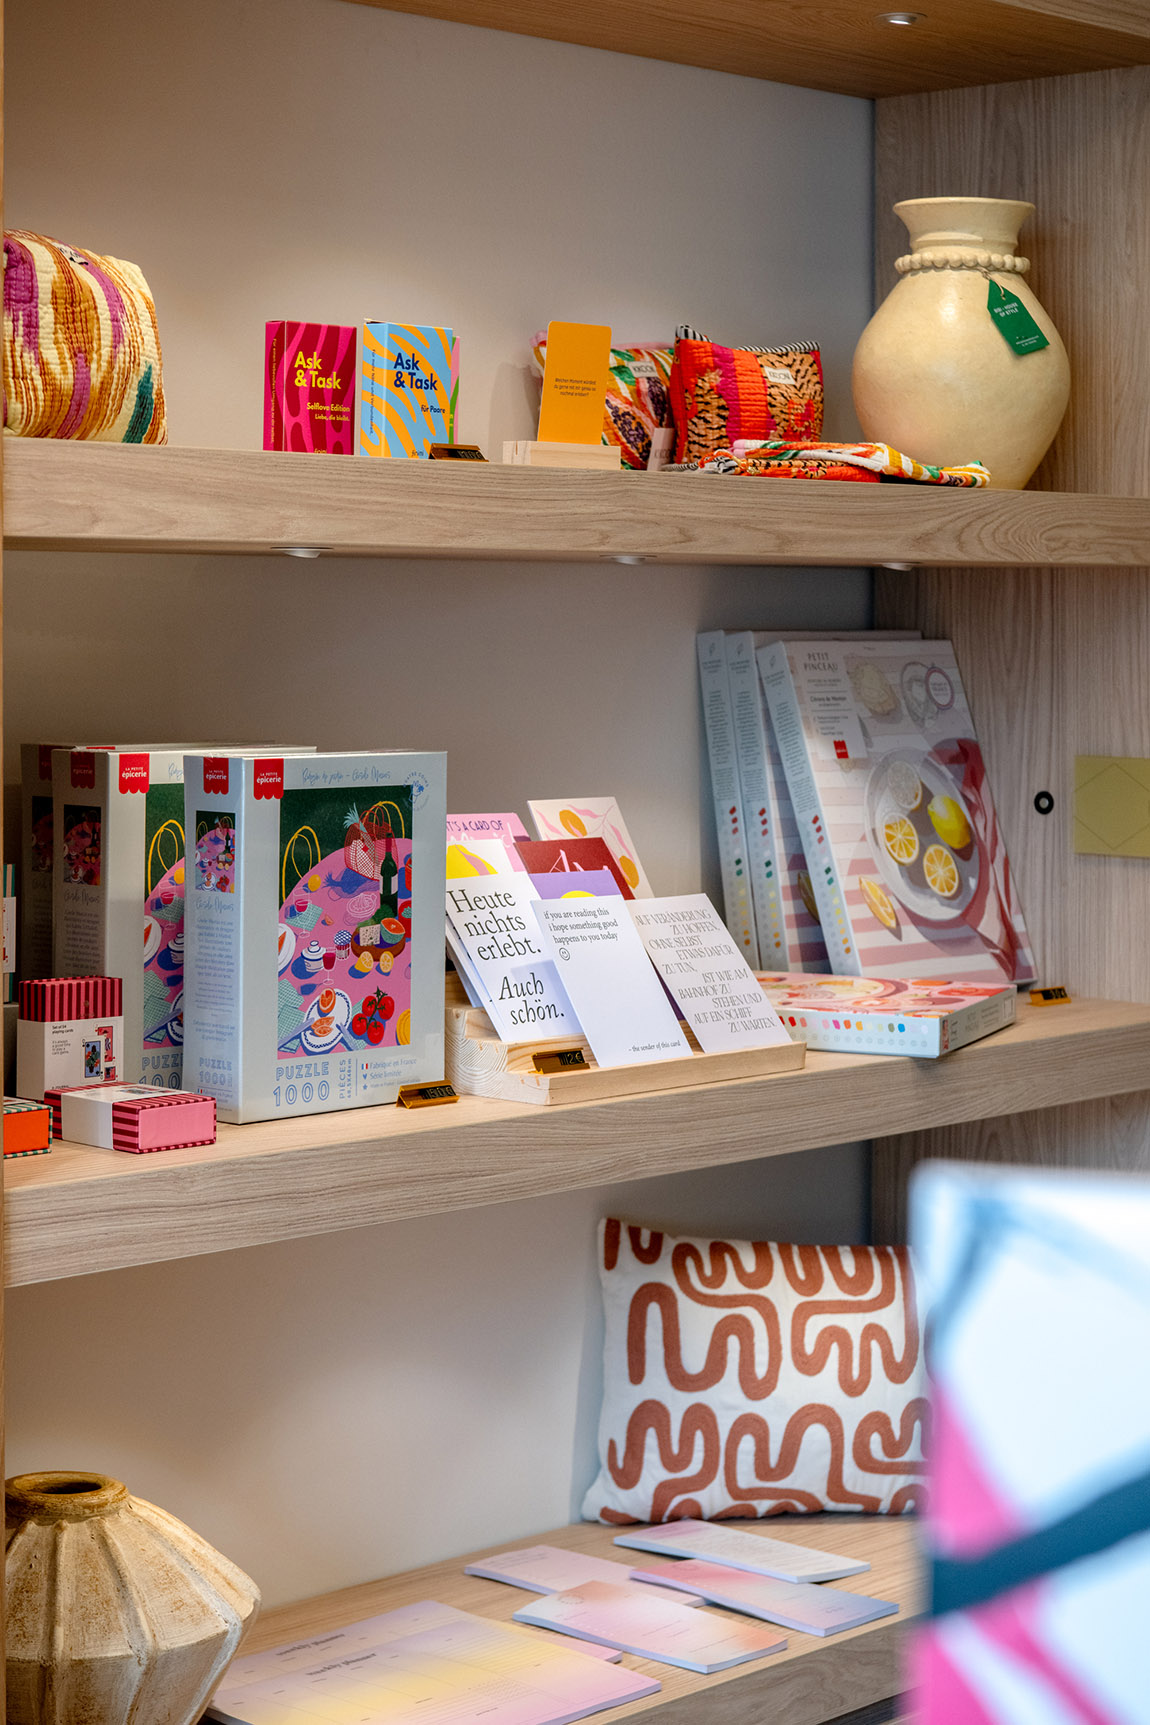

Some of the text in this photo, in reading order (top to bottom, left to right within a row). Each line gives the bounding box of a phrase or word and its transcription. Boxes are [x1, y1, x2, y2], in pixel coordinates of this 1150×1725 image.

[294, 351, 322, 370] Ask
[394, 352, 420, 371] Ask
[294, 370, 342, 390] & Task
[394, 370, 438, 391] & Task
[306, 402, 350, 412] Selflove Edition
[420, 404, 446, 414] für Paare
[808, 652, 830, 661] PETIT
[804, 662, 838, 672] PINCEAU
[122, 771, 147, 779] épicerie
[256, 776, 282, 785] épicerie
[462, 822, 469, 831] A
[468, 820, 490, 831] CARD
[490, 820, 504, 831] OF
[446, 889, 516, 913] Heute
[544, 910, 550, 919] if
[550, 912, 562, 921] you
[574, 908, 598, 918] reading
[597, 907, 610, 916] this
[651, 909, 712, 924] VERÄNDERUNG
[464, 911, 526, 936] nichts
[552, 922, 569, 933] hope
[569, 920, 602, 930] something
[602, 918, 618, 930] good
[670, 924, 684, 935] ZU
[552, 935, 580, 946] happens
[588, 934, 600, 943] you
[600, 931, 618, 941] today
[674, 935, 702, 948] SELBST
[478, 934, 541, 960] erlebt.
[676, 944, 734, 960] ETWAS DAFÜR
[662, 962, 675, 974] ZU
[702, 968, 749, 983] IST WIE AM
[498, 972, 544, 1000] Auch
[678, 983, 732, 1000] BAHNHOF ZU
[712, 992, 762, 1008] STEHEN UND
[510, 999, 564, 1025] schön.
[694, 1006, 752, 1024] AUF EIN SCHIFF
[728, 1022, 741, 1033] ZU
[640, 1044, 655, 1052] sender
[670, 1040, 681, 1048] card
[200, 1056, 232, 1071] PUZZLE
[567, 1052, 583, 1064] 2€
[200, 1071, 225, 1085] 1000
[276, 1061, 329, 1081] PUZZLE
[338, 1060, 346, 1099] PIÈCES
[273, 1080, 330, 1107] 1000
[342, 1653, 376, 1665] planner
